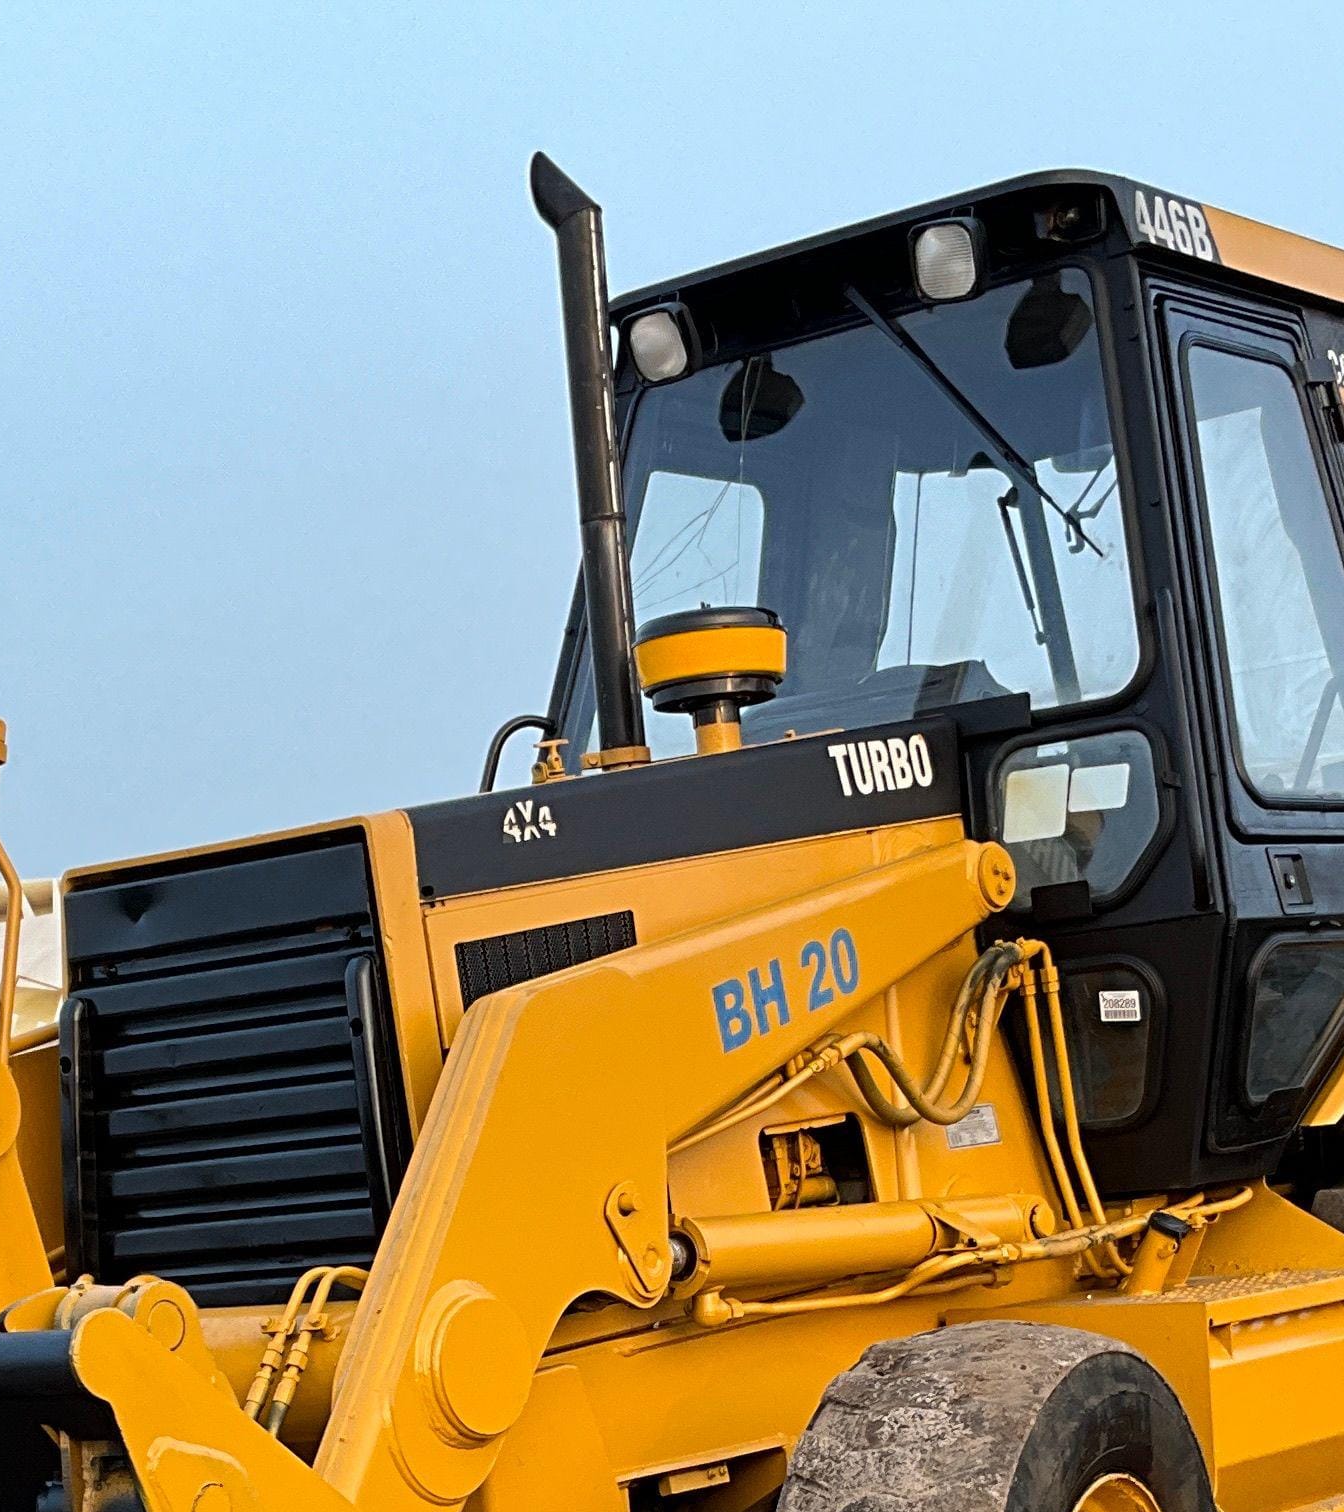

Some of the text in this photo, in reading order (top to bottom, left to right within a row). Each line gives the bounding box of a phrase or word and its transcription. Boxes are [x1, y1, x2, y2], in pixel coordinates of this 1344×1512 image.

[1135, 190, 1213, 262] 446B
[828, 734, 933, 797] TURBO
[503, 800, 557, 843] 4X4
[712, 927, 859, 1055] BH 20
